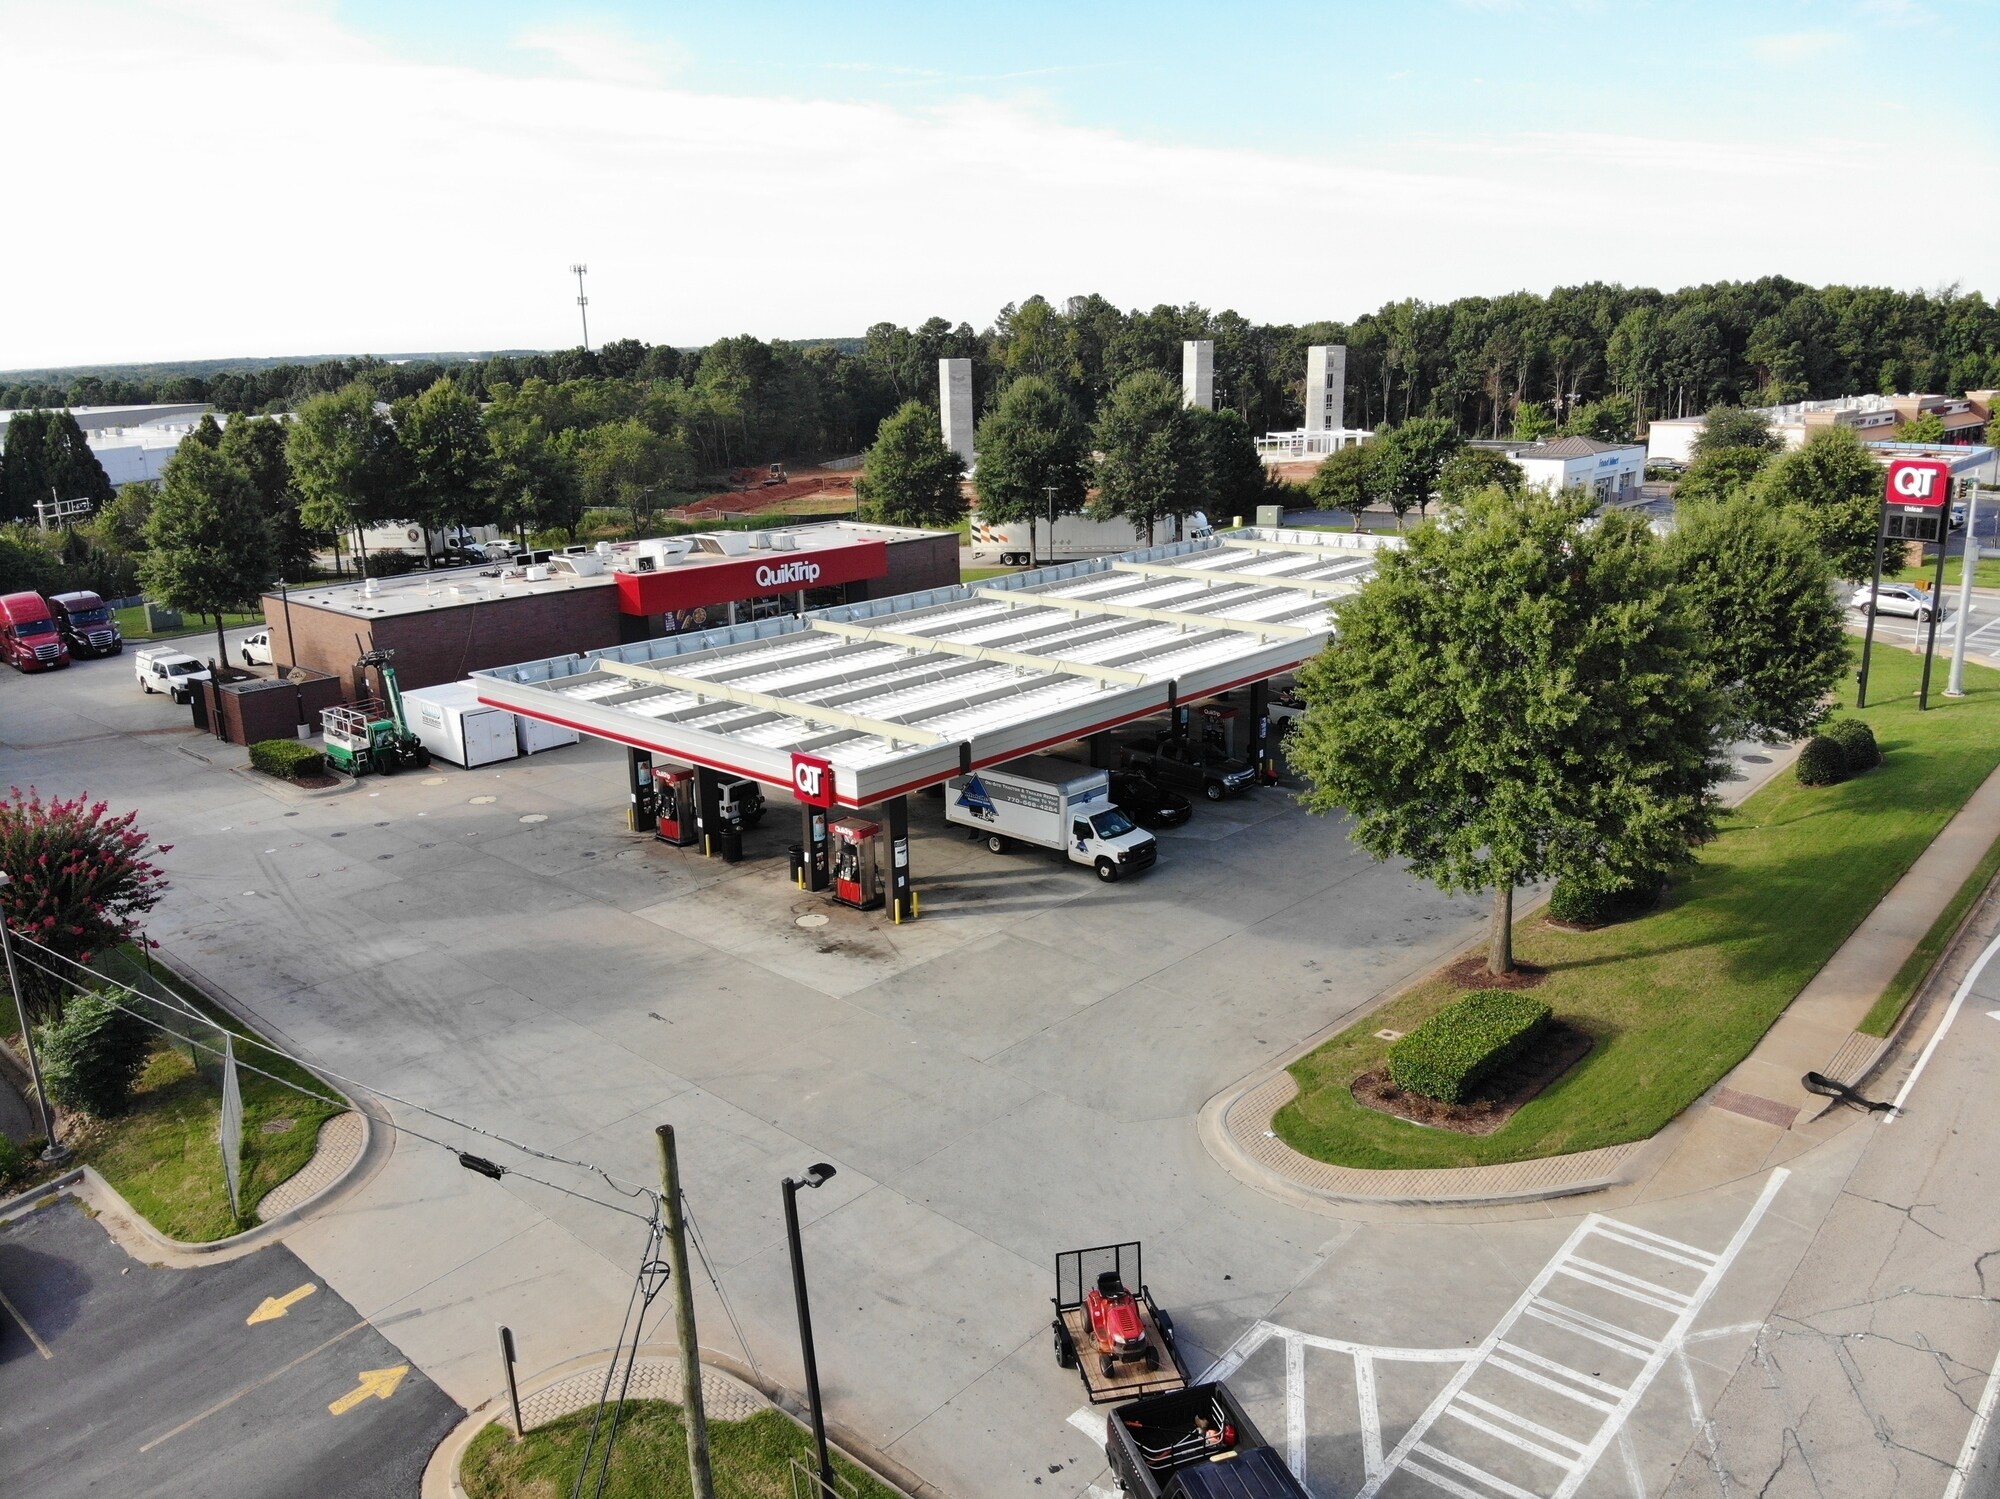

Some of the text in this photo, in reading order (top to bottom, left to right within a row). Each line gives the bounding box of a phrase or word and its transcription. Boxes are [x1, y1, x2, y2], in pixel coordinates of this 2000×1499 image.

[1894, 467, 1937, 498] QT
[1904, 505, 1924, 513] Unlead
[756, 561, 820, 587] QuikTrip
[795, 762, 822, 796] QT
